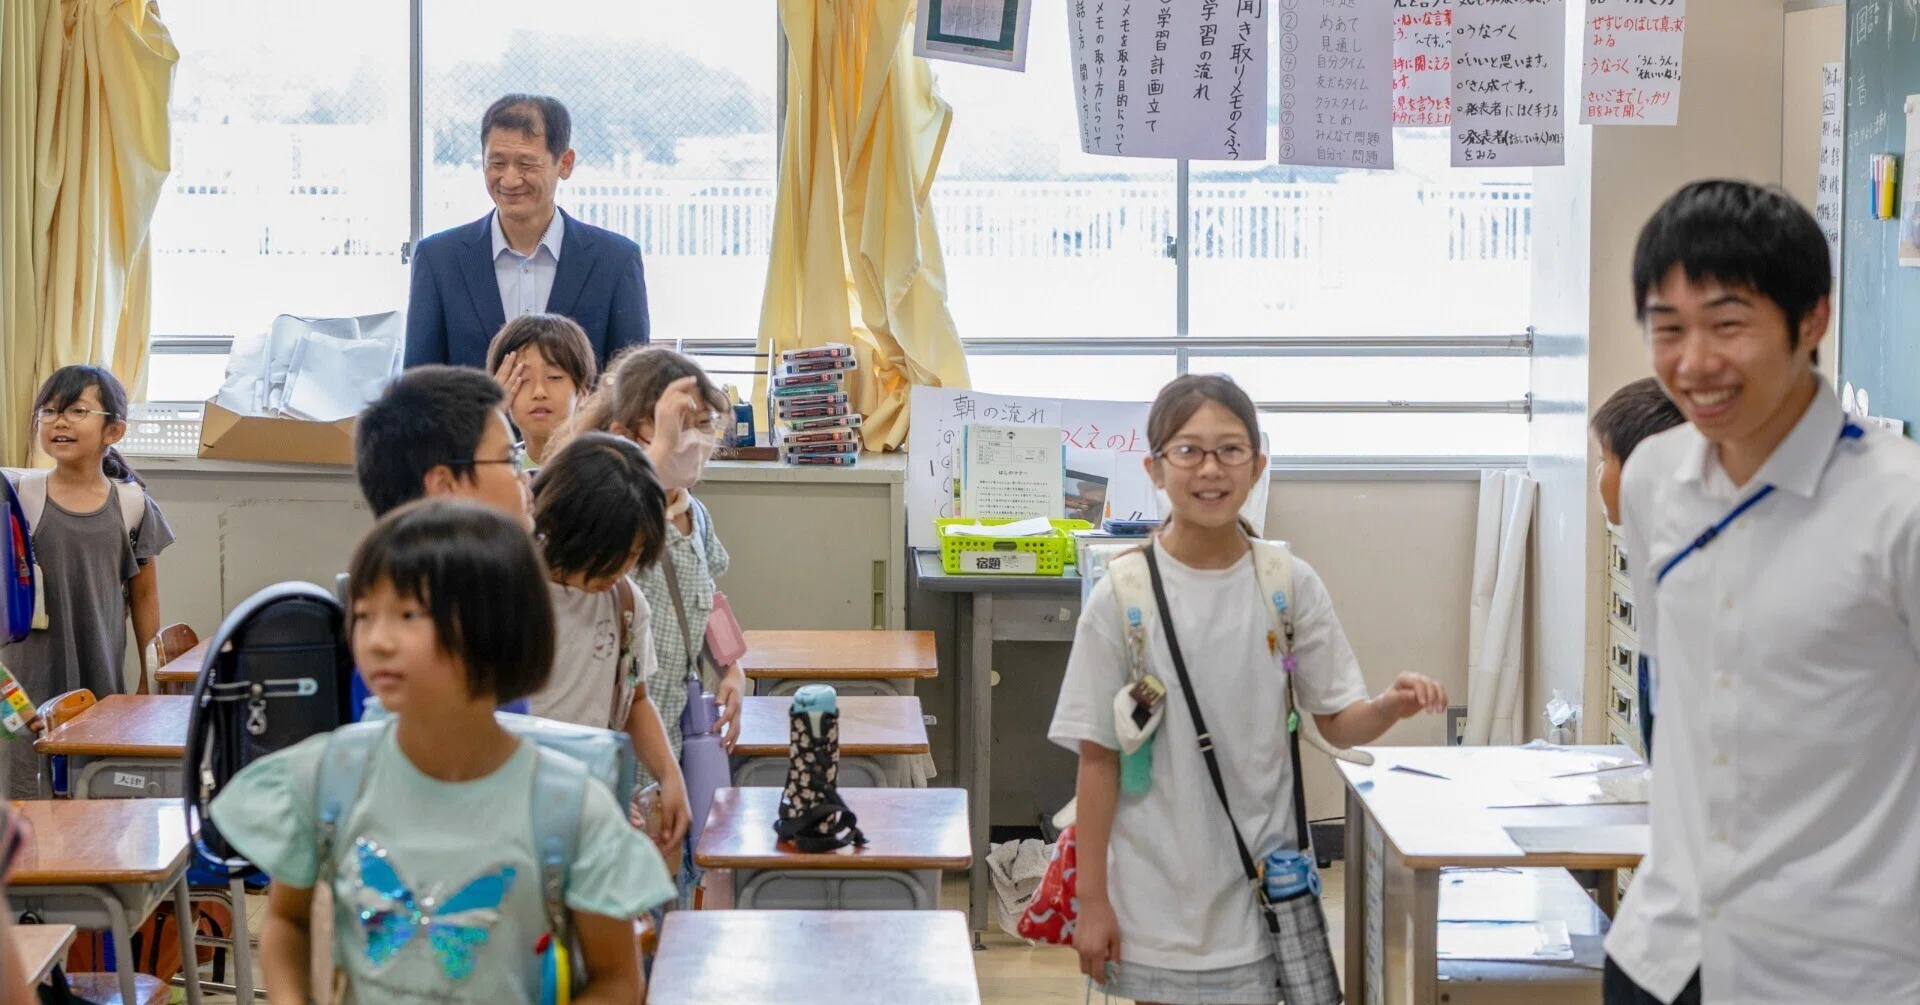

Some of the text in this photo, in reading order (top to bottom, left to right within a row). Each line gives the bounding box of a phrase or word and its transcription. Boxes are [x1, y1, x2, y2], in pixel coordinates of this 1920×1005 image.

[1319, 14, 1360, 32] めあて
[1321, 35, 1363, 53] 見通し
[1593, 34, 1616, 47] みる
[1317, 54, 1366, 70] 自分タイム
[1315, 74, 1369, 91] 友だちタイム
[1315, 96, 1369, 111] クラスタイム
[1316, 113, 1352, 126] まとめ
[1464, 148, 1497, 161] をみる
[952, 393, 1045, 423] 朝の流れ
[976, 557, 1001, 570] 宿題
